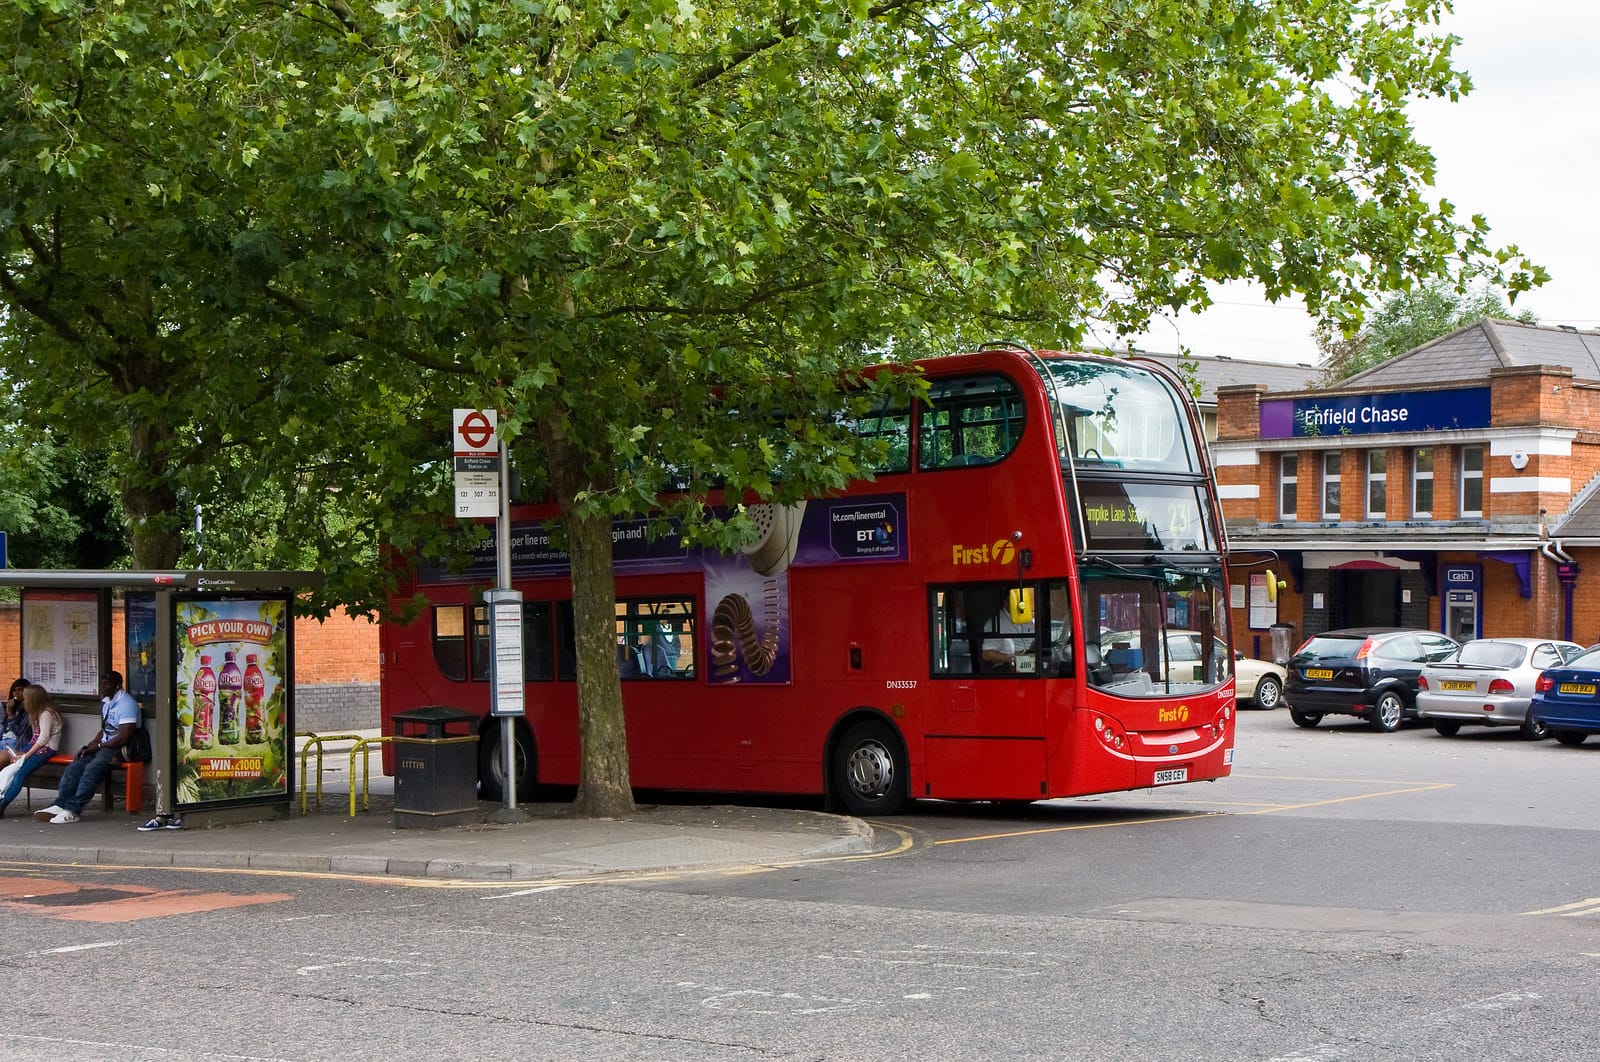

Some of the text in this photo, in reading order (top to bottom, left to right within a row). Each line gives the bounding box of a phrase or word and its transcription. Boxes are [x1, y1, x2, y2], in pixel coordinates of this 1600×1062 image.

[1305, 407, 1408, 425] Enfield Chase
[832, 509, 886, 522] bt.com/linerental
[1086, 503, 1109, 526] urnpike
[1111, 503, 1126, 522] Lane
[1168, 503, 1191, 532] 231
[626, 526, 641, 539] and
[856, 529, 875, 541] BT
[482, 537, 494, 551] get
[525, 534, 538, 546] line
[521, 552, 536, 560] month
[536, 551, 549, 559] when
[550, 551, 558, 560] you
[558, 550, 568, 560] pay
[952, 544, 989, 565] First
[1453, 571, 1469, 580] cash
[191, 624, 216, 639] PICK
[219, 622, 244, 635] YOUR
[246, 623, 270, 636] OWN
[886, 680, 917, 689] DN33537
[1159, 707, 1177, 722] First
[210, 759, 231, 770] WIN
[234, 759, 261, 771] £1000
[402, 760, 425, 769] LITTER
[1156, 769, 1185, 782] SN58 CEY
